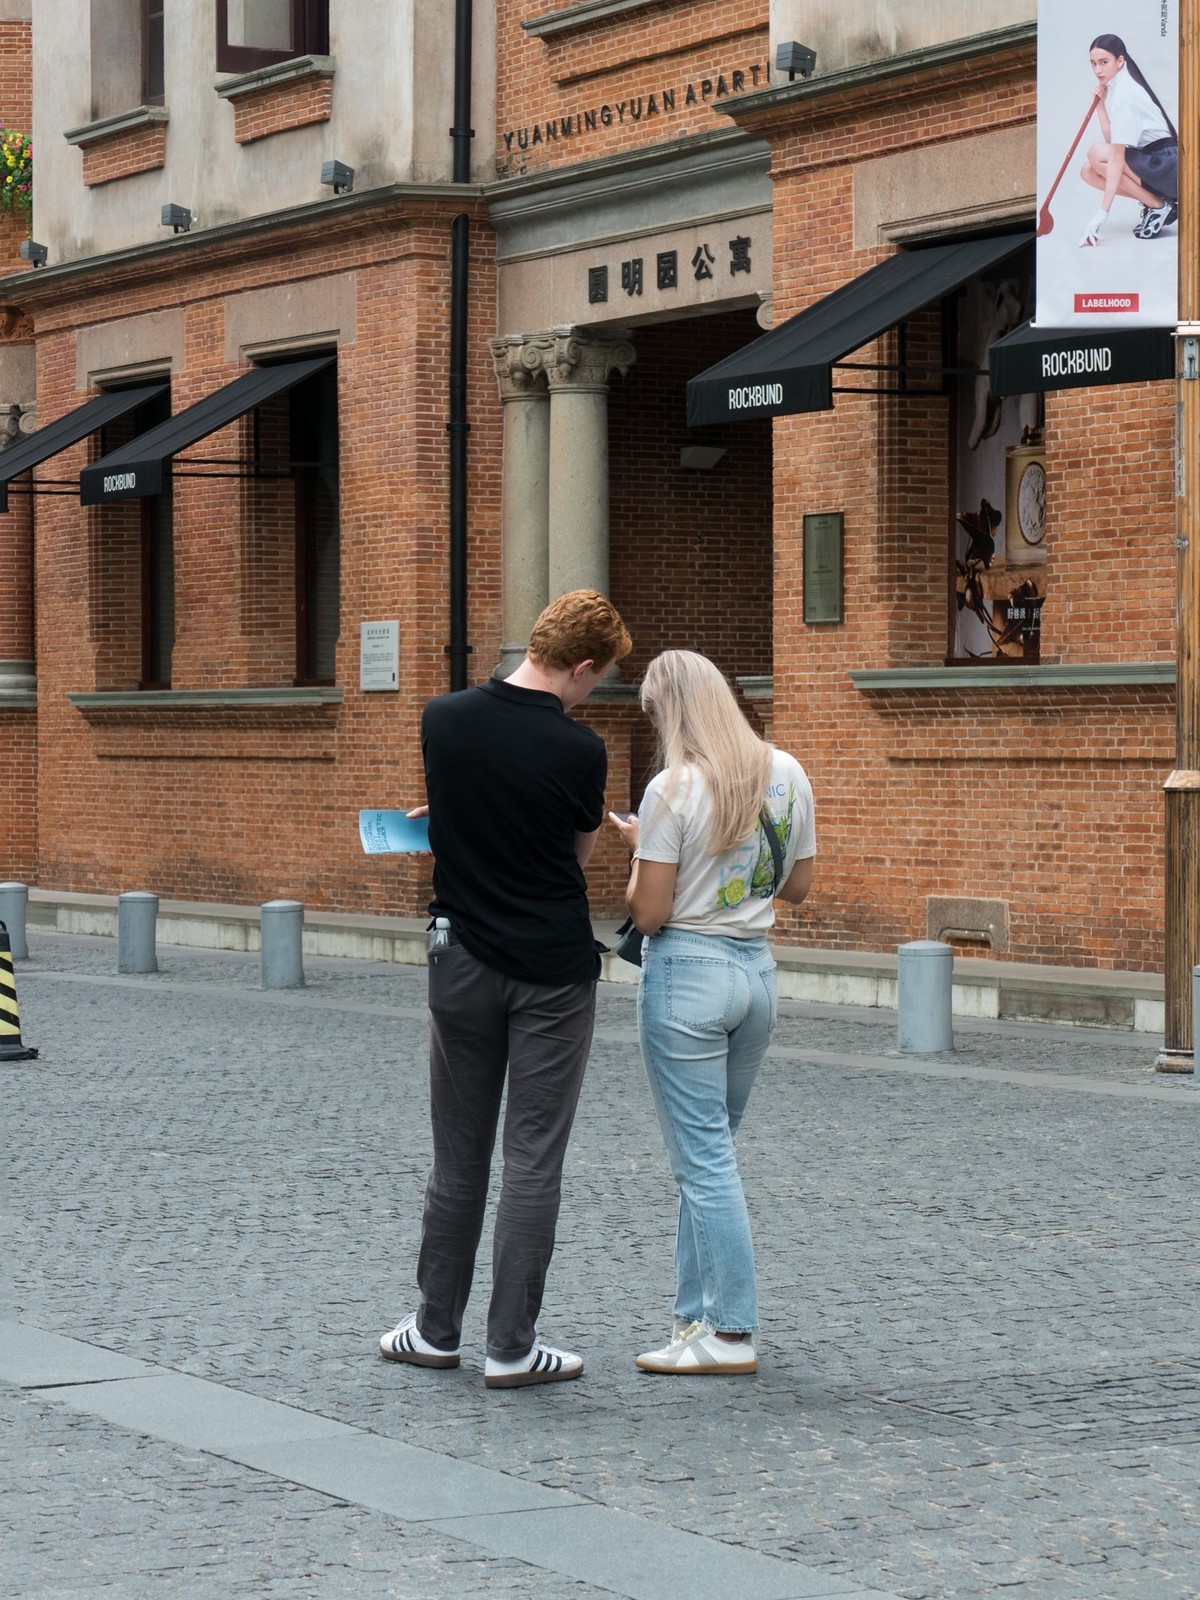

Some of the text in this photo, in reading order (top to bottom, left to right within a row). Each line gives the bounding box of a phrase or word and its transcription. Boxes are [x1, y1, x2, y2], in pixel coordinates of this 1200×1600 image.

[503, 89, 675, 151] YUANMINGYUAN
[588, 235, 752, 304] 圆明园公寓
[1082, 298, 1131, 308] LABELHOOD
[1041, 347, 1112, 377] ROCKBUND
[728, 383, 784, 410] ROCKBUND
[103, 472, 136, 493] ROCKBUND
